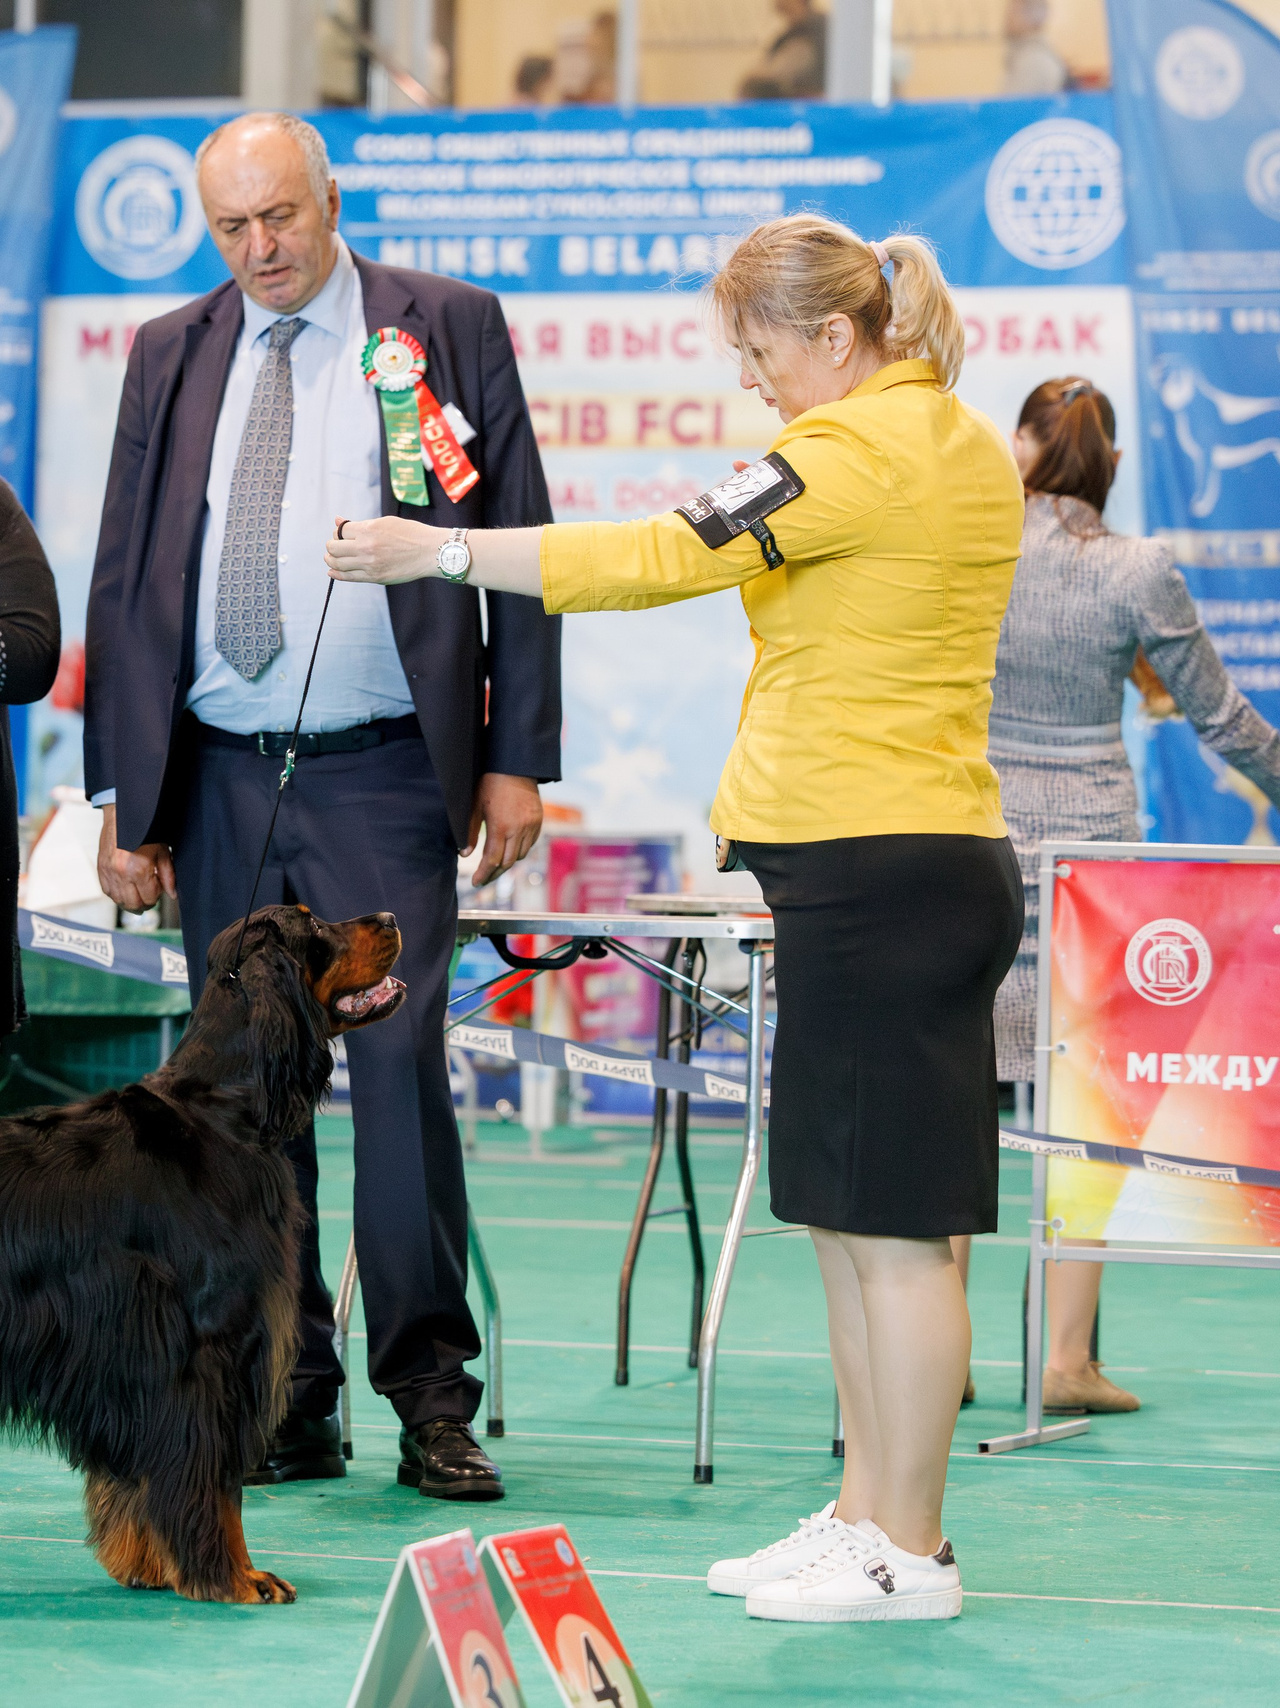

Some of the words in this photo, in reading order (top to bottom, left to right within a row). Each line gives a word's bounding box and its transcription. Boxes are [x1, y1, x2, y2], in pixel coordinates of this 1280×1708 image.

[379, 238, 528, 277] MINSK
[560, 234, 738, 276] BELAR
[964, 314, 1103, 358] ОБАК
[636, 400, 724, 445] FCI
[683, 499, 708, 520] Brit
[711, 1082, 740, 1100] DOG
[1126, 1051, 1279, 1091] МЕЖДУ
[583, 1634, 626, 1708] 4
